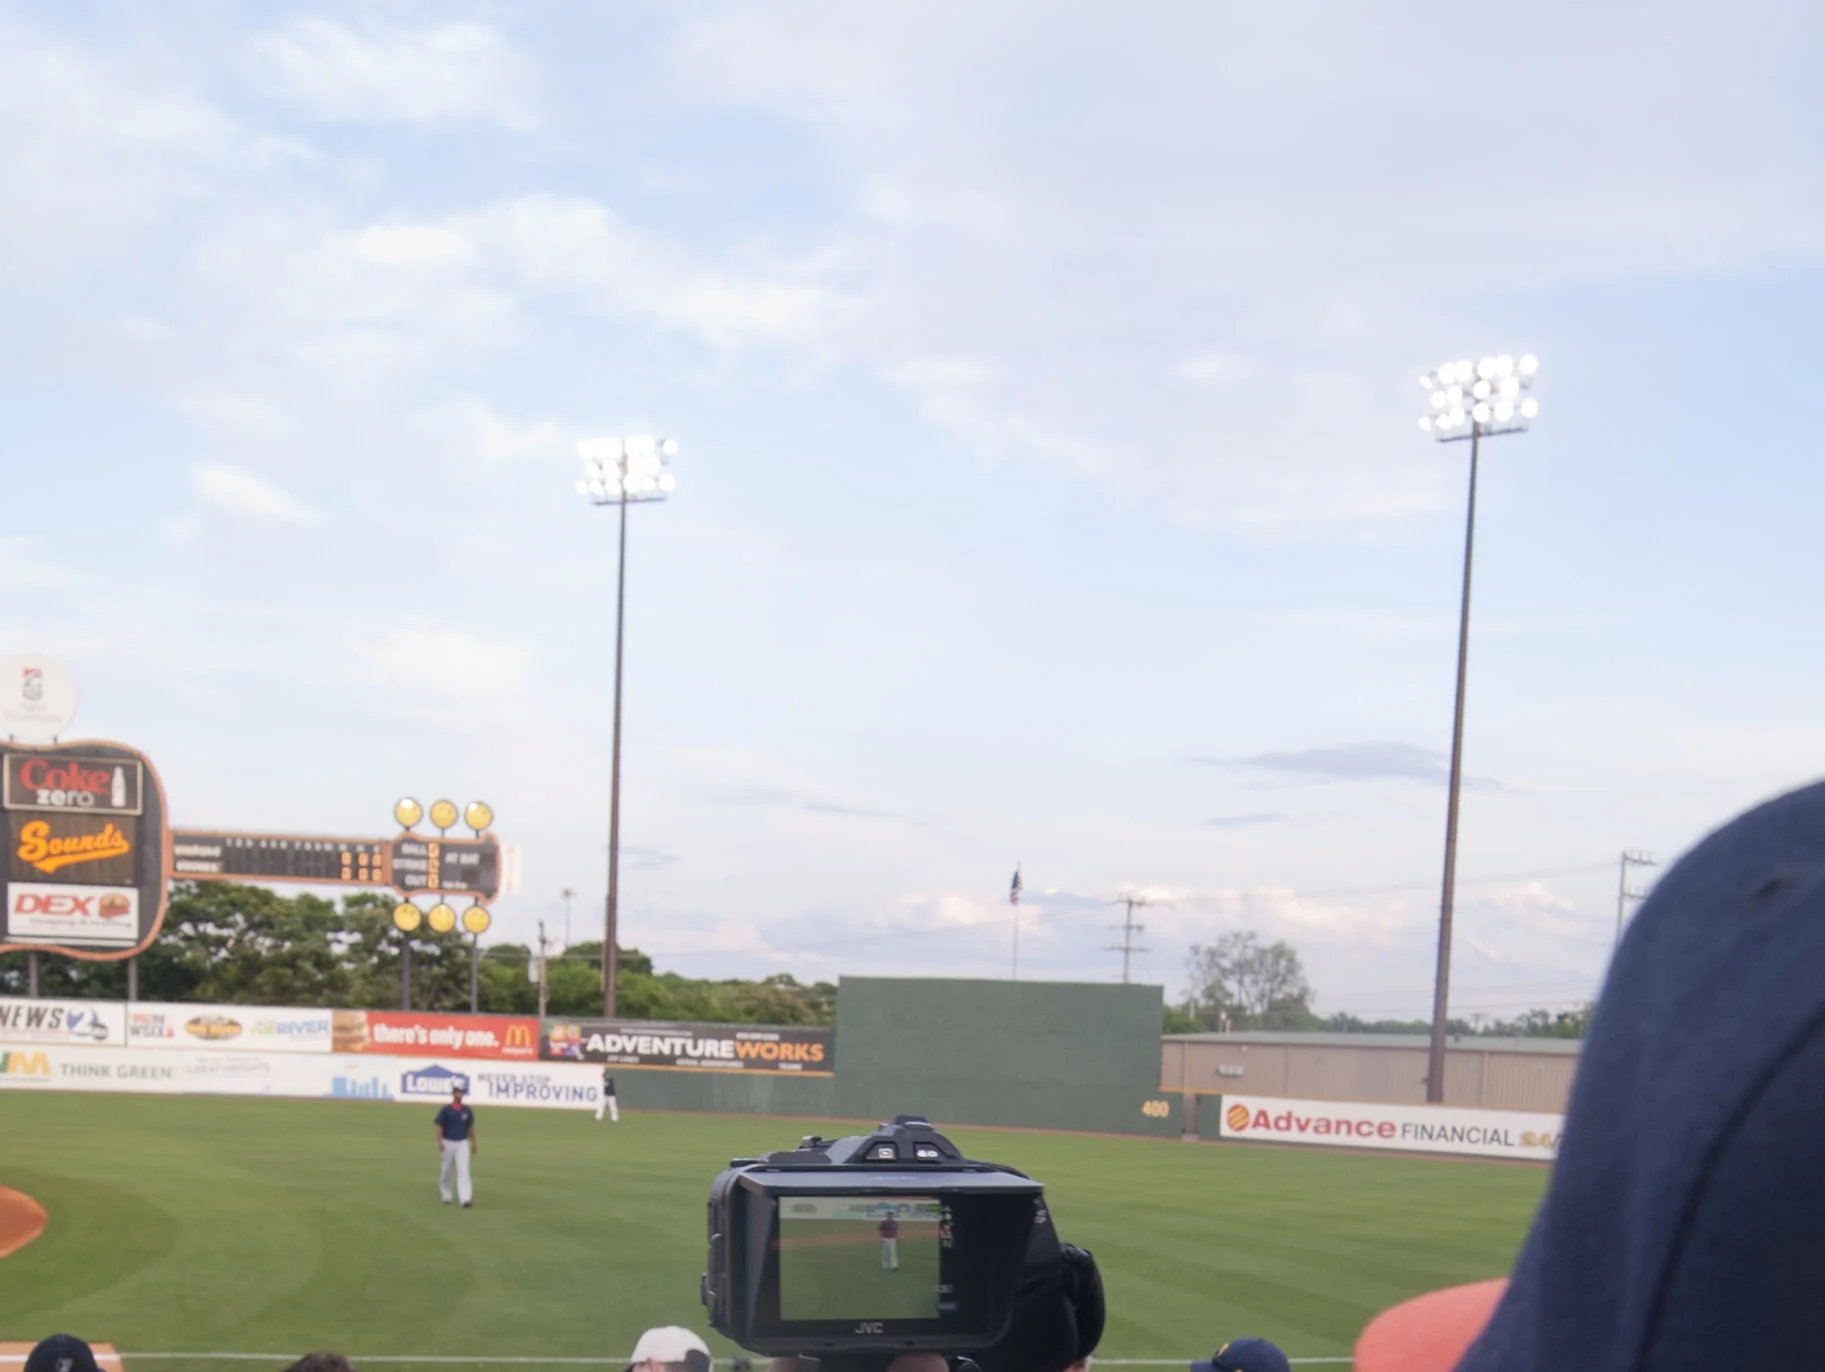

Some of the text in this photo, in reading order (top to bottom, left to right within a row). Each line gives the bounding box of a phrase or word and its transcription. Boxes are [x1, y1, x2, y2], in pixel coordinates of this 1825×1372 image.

[20, 757, 110, 794] Coke
[36, 788, 95, 807] zero
[17, 820, 130, 870] Sounds
[15, 894, 94, 915] DEX
[373, 1023, 428, 1045] there's
[429, 1025, 464, 1050] only
[61, 1062, 111, 1078] THINK
[477, 1073, 516, 1083] NEVER
[488, 1080, 598, 1102] IMPROVING
[1141, 1100, 1170, 1118] 400
[1251, 1109, 1397, 1139] Advance
[1401, 1123, 1514, 1148] FINANCIAL
[855, 1322, 884, 1334] JVC
